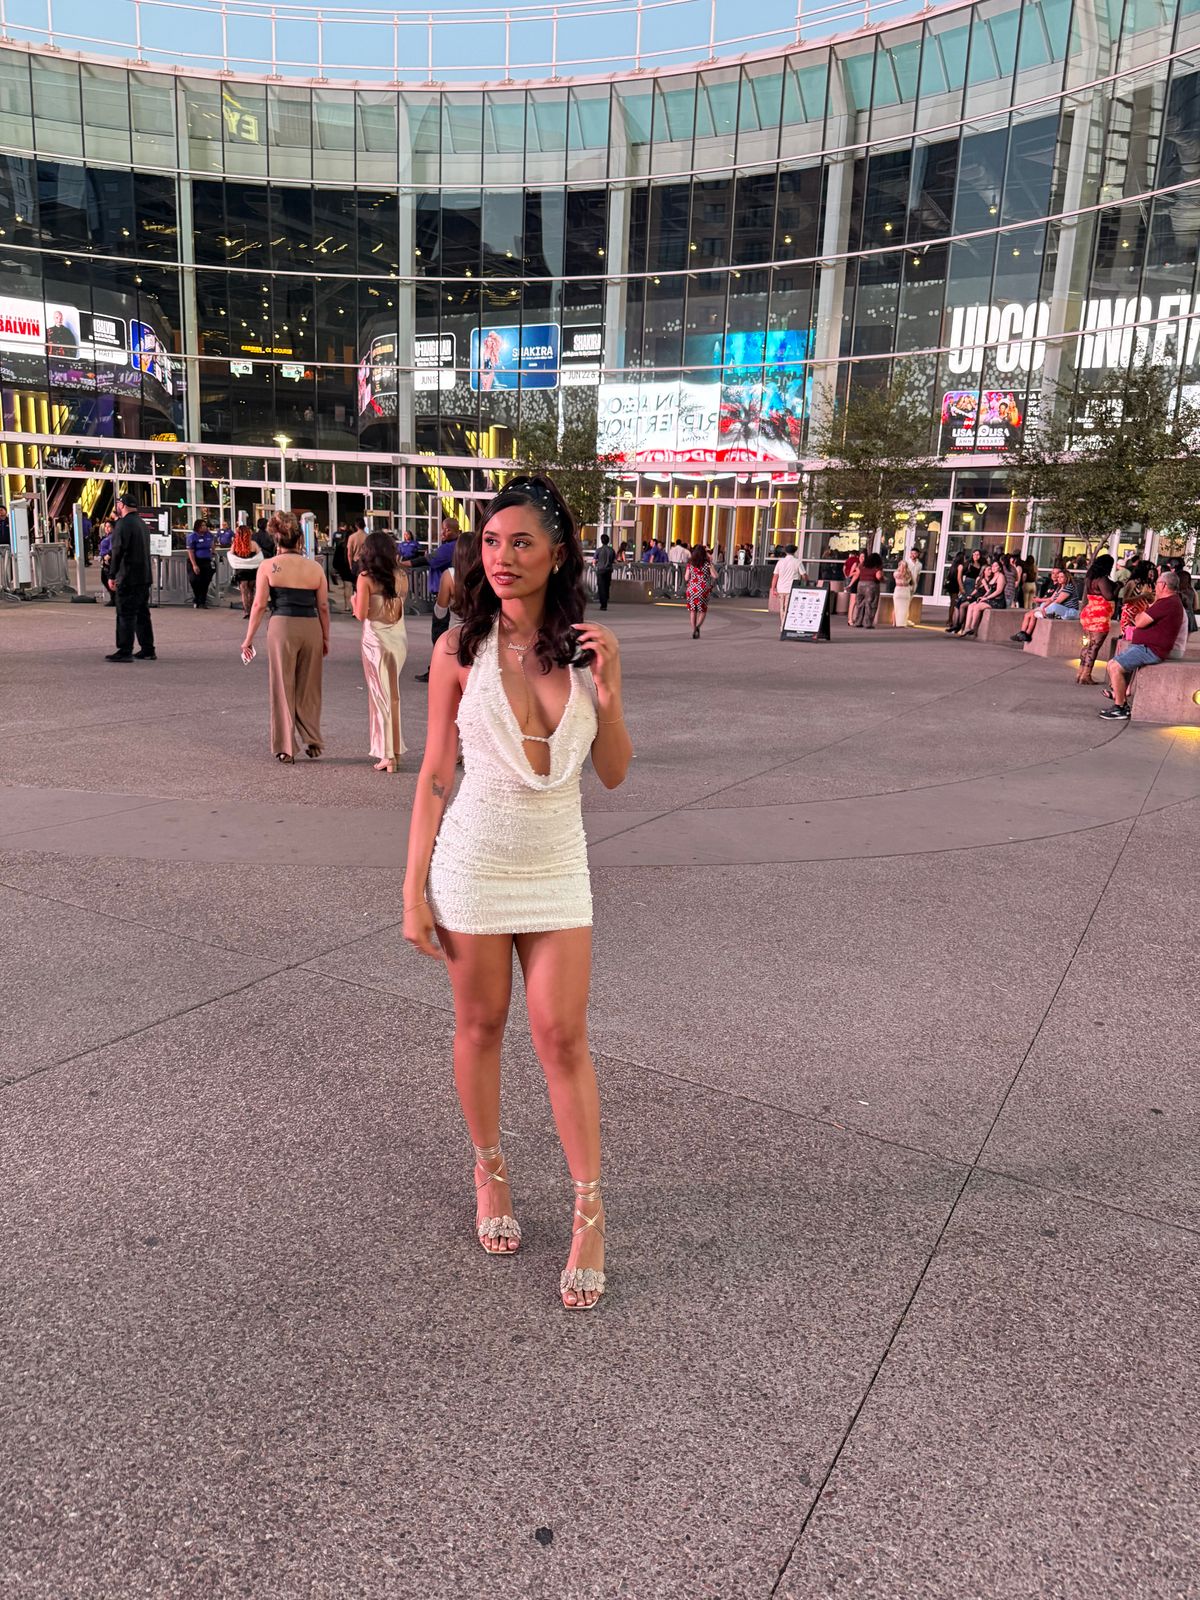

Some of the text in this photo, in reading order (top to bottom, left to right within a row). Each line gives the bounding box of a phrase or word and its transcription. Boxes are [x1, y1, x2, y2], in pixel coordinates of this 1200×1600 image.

[0, 319, 40, 337] BALVIN
[948, 296, 1152, 374] UPCOING
[512, 345, 553, 357] SHAKIRA
[952, 428, 973, 437] LISA
